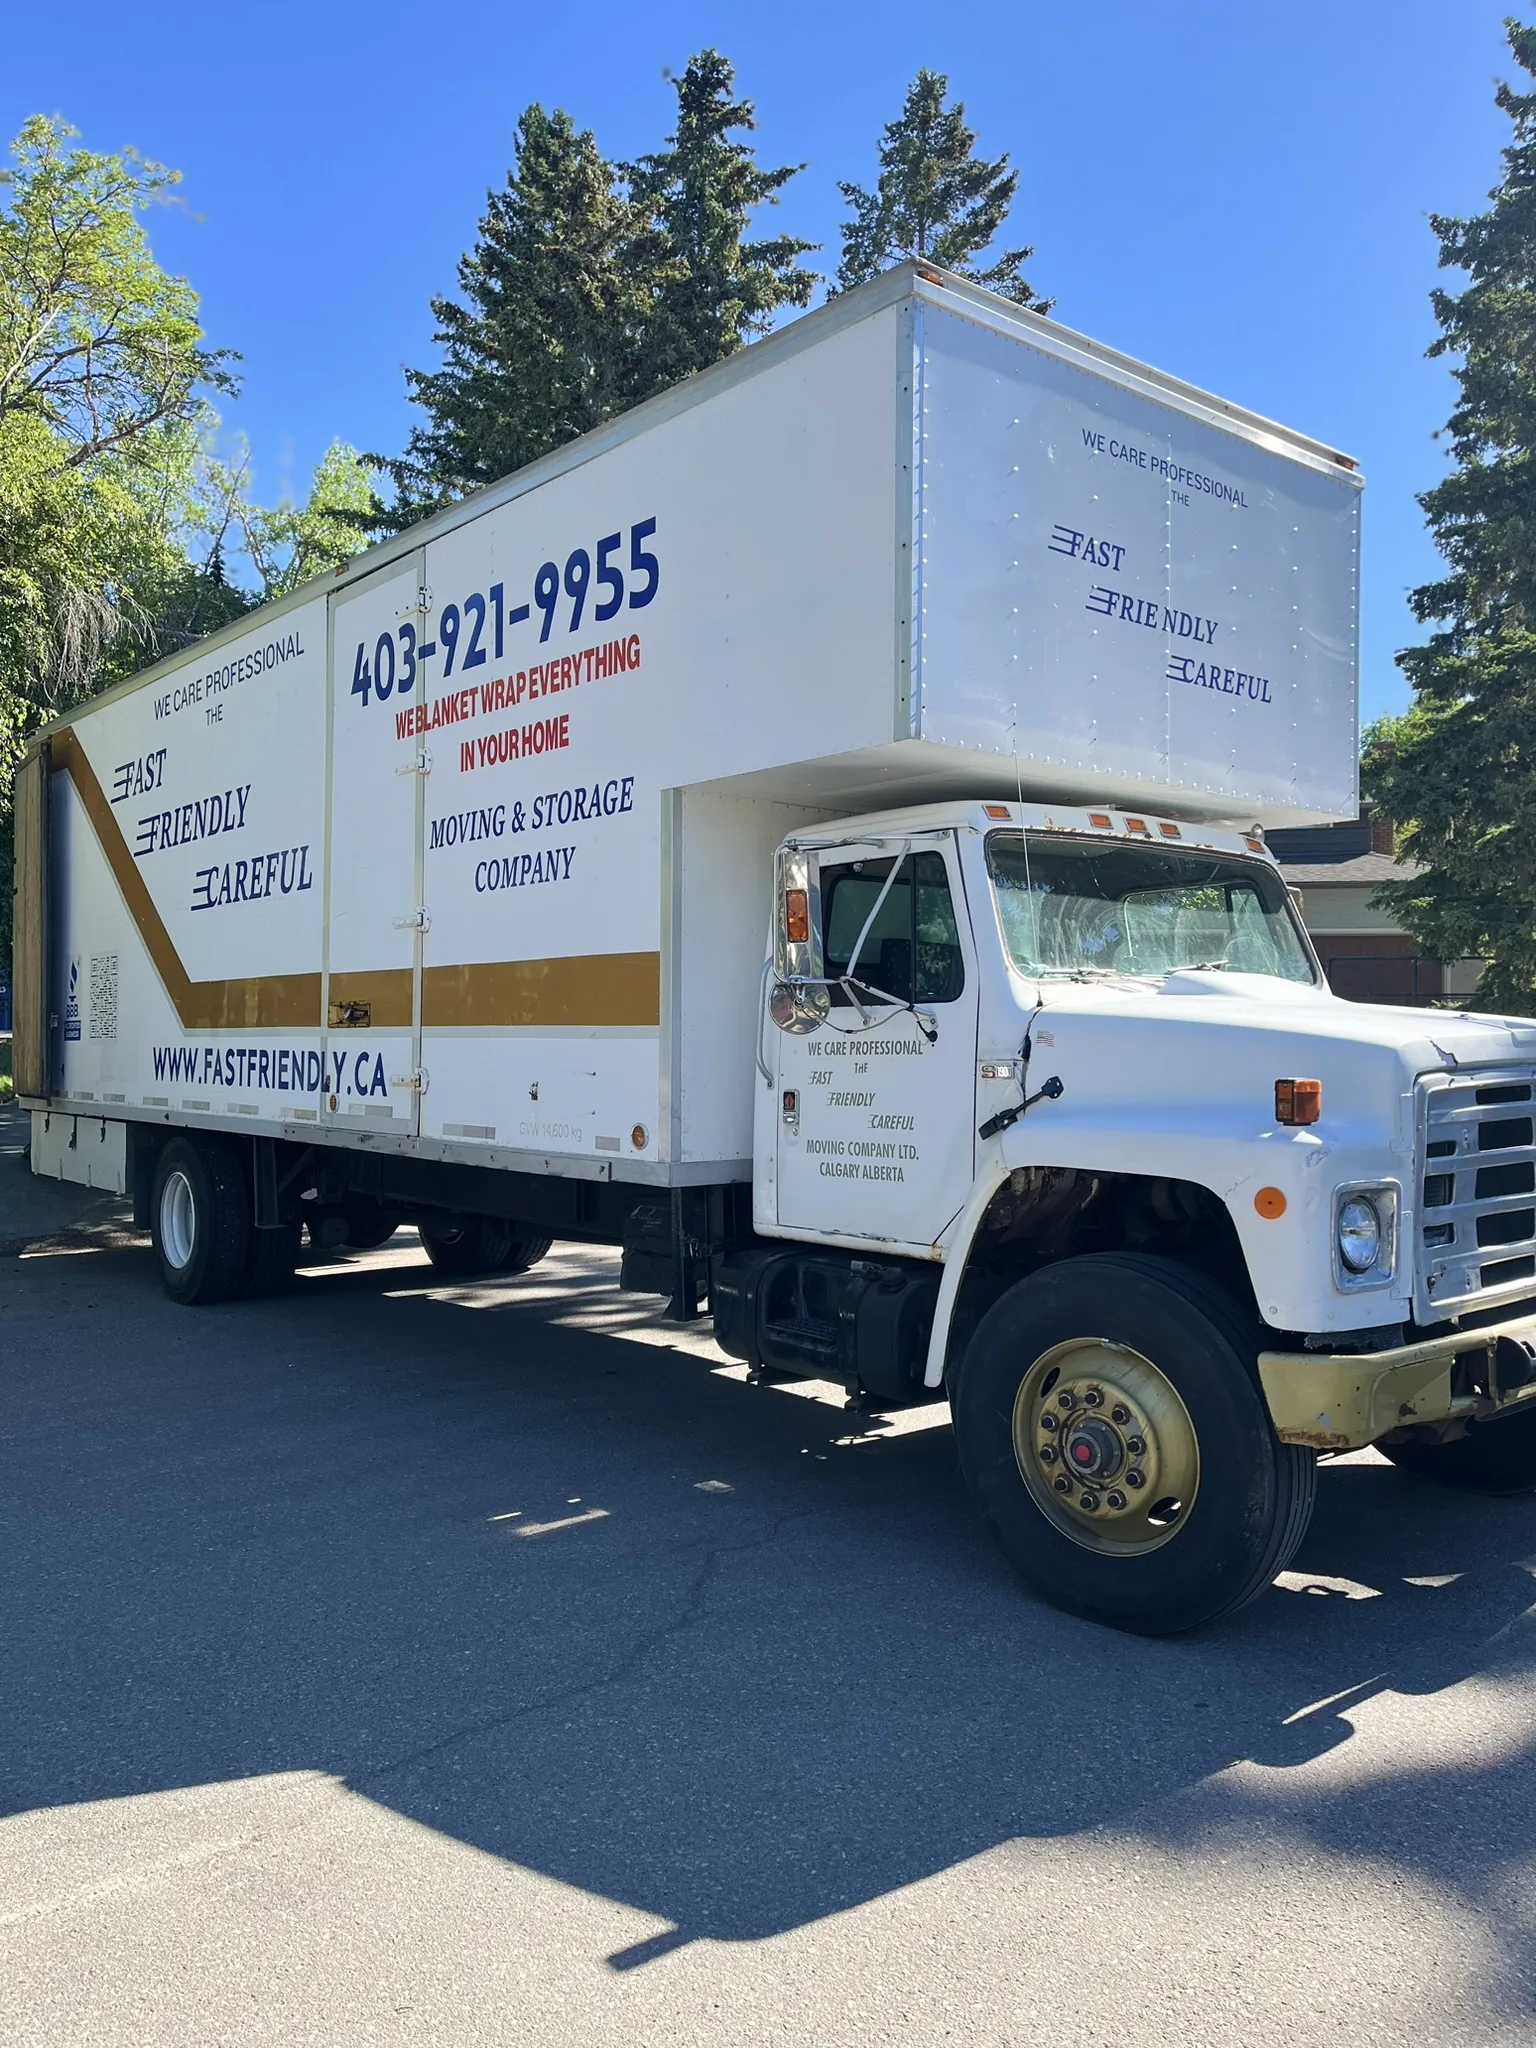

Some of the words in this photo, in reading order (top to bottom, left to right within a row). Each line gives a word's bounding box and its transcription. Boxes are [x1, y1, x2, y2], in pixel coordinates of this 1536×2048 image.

[1082, 428, 1106, 453] WE
[1109, 440, 1148, 469] CARE
[1150, 456, 1249, 508] PROFESSIONAL
[1171, 490, 1190, 507] THE
[1048, 525, 1126, 572] FAST
[351, 516, 660, 708] 403-921-9955
[1086, 585, 1219, 645] FRIENDLY
[154, 694, 171, 720] WE
[173, 679, 203, 712] CARE
[206, 631, 305, 698] PROFESSIONAL
[395, 711, 415, 740] WE
[415, 684, 479, 732] BLANKET
[481, 670, 526, 713] WRAP
[528, 634, 641, 699] EVERYTHING
[1166, 654, 1272, 704] CAREFUL
[206, 704, 223, 726] THE
[460, 741, 476, 773] IN
[477, 728, 520, 766] YOUR
[521, 714, 569, 757] HOME
[110, 748, 167, 804] FAST
[134, 784, 251, 858] FRIENDLY
[429, 805, 505, 850] MOVING
[511, 802, 526, 834] &
[531, 776, 635, 830] STORAGE
[190, 845, 313, 912] CAREFUL
[474, 846, 576, 893] COMPANY
[66, 1003, 79, 1018] BBB
[152, 1046, 388, 1097] WWW.FASTFRIENDLY.CA
[808, 1041, 822, 1056] WE
[824, 1041, 847, 1056] CARE
[849, 1040, 923, 1055] PROFESSIONAL
[854, 1062, 868, 1073] THE
[808, 1071, 833, 1085] FAST
[826, 1092, 876, 1107] FRIENDLY
[520, 1121, 540, 1136] GVW
[542, 1123, 569, 1139] 14,600
[571, 1126, 582, 1142] kg
[867, 1114, 914, 1130] CAREFUL
[806, 1139, 845, 1155] MOVING
[847, 1141, 896, 1158] COMPANY
[898, 1144, 919, 1160] LTD.
[819, 1162, 860, 1178] CALGARY
[862, 1165, 904, 1182] ALBERTA
